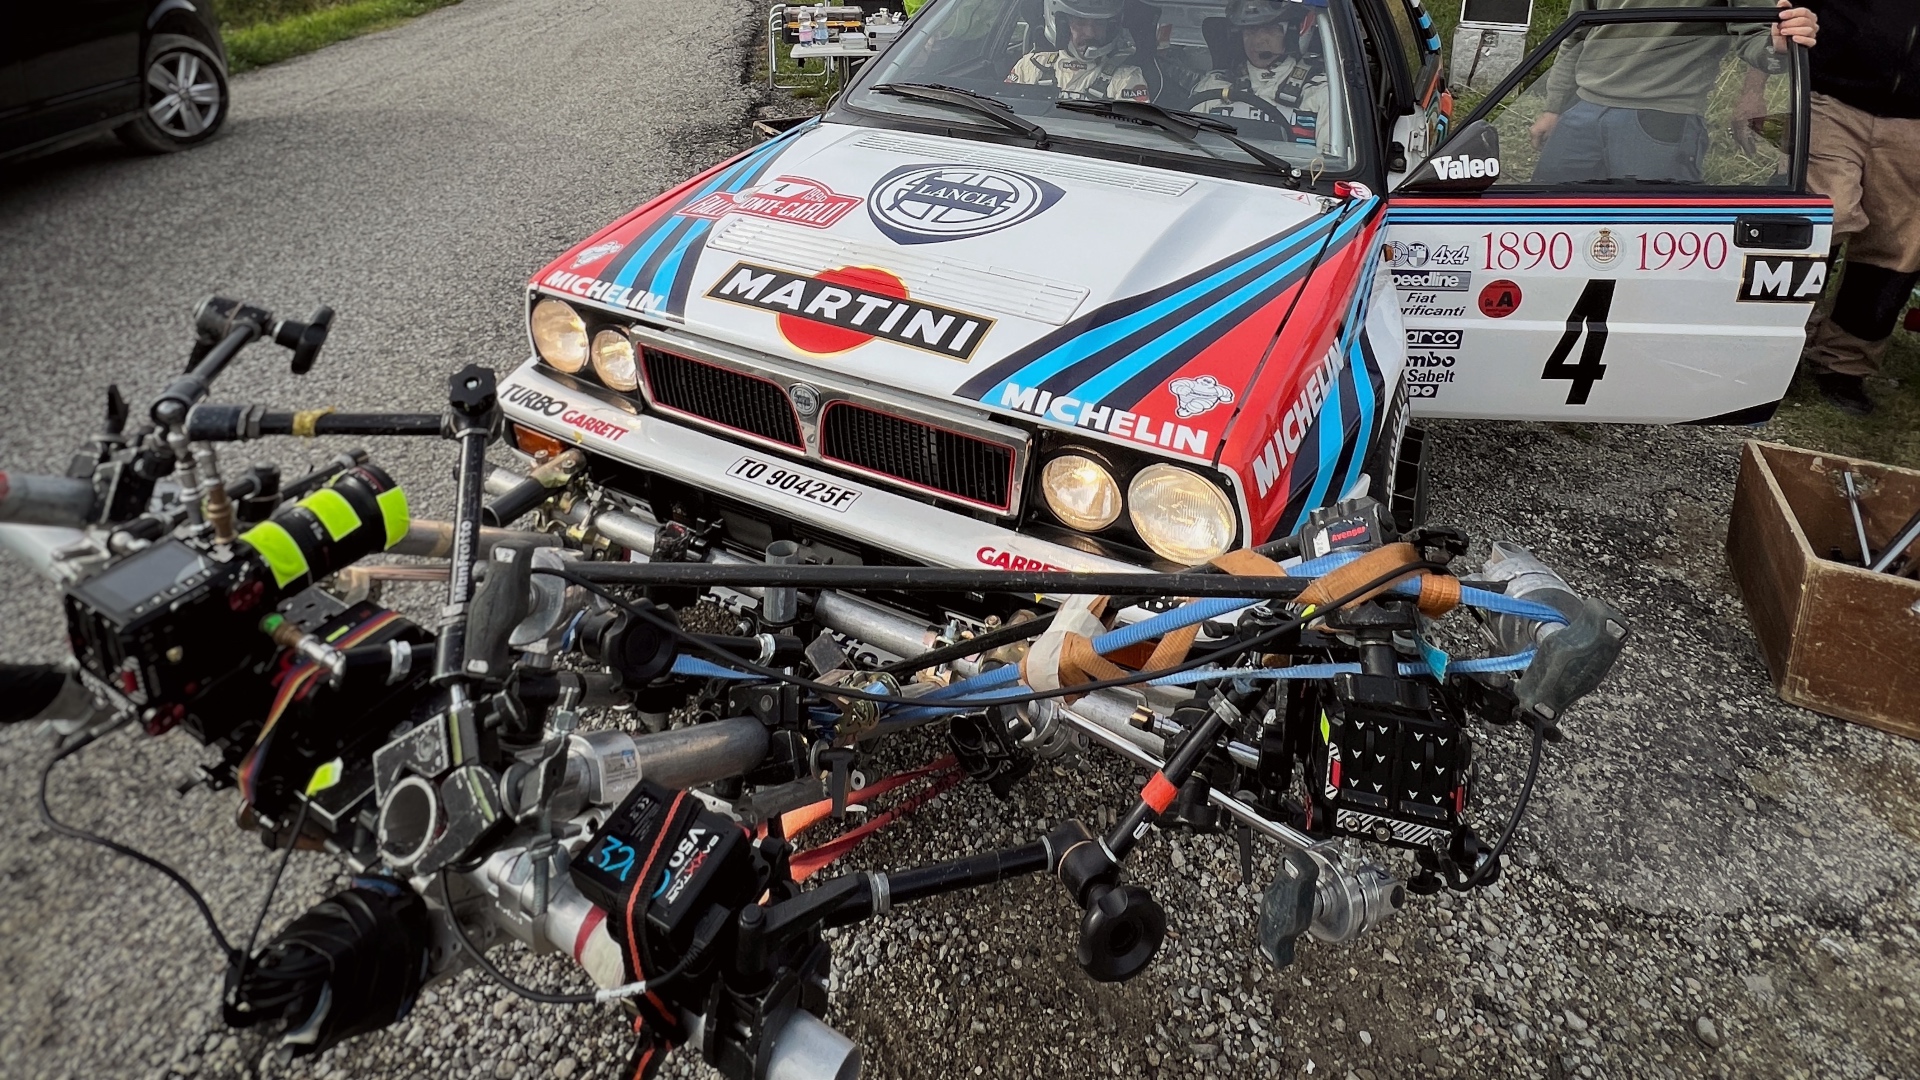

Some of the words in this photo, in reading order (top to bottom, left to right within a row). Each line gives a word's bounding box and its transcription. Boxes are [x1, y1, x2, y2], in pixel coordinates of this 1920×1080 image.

[1430, 154, 1500, 180] Valeo
[915, 184, 999, 208] LANCIA
[739, 196, 850, 223] ONTE-CARLO
[1431, 244, 1470, 265] 4x4
[1480, 231, 1573, 270] 1890
[1635, 231, 1728, 271] 1990
[544, 270, 665, 312] MICHELIN
[1393, 271, 1459, 288] peedline
[719, 268, 979, 352] MARTINI
[1401, 304, 1466, 317] rificanti
[1406, 292, 1437, 304] Fiat
[1406, 330, 1460, 344] arco
[1540, 278, 1617, 406] 4
[1406, 351, 1456, 368] mbo
[1407, 368, 1456, 383] Sabelt
[1408, 385, 1435, 397] DO
[500, 383, 568, 417] TURBO
[561, 409, 630, 441] GARRETT
[1000, 382, 1209, 455] MICHELIN
[1252, 336, 1345, 499] MICHELIN
[734, 458, 769, 480] TO
[765, 470, 856, 507] 90425F
[1331, 525, 1367, 543] Avenger
[454, 520, 473, 602] Manfrotto
[668, 828, 706, 868] V50
